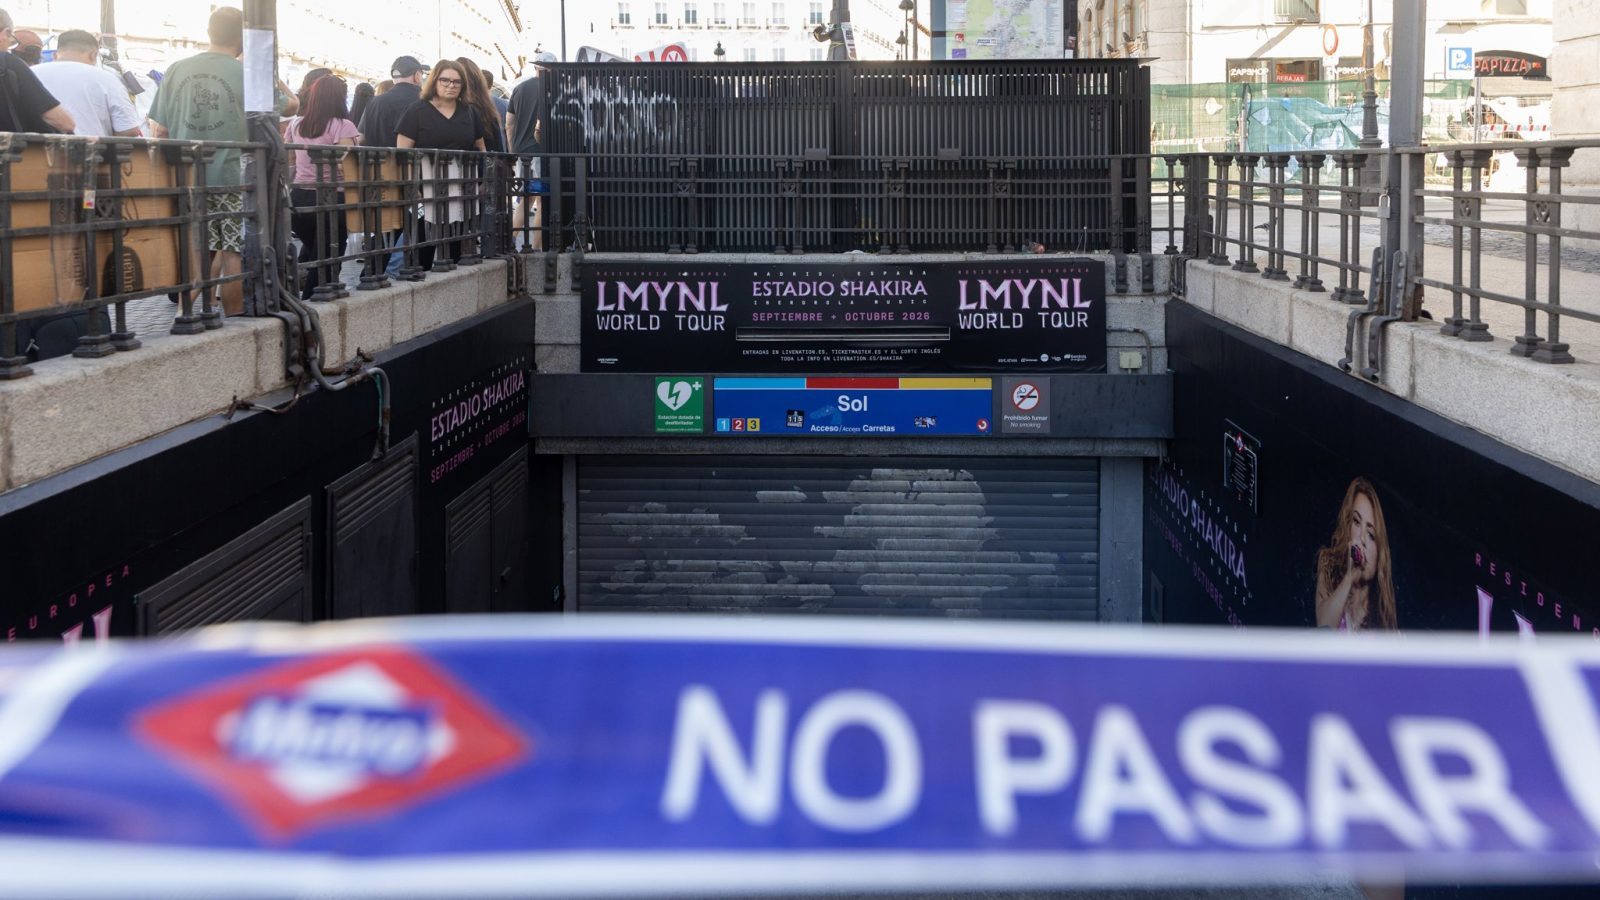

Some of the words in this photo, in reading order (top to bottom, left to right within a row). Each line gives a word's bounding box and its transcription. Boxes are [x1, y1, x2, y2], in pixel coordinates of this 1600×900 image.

[1230, 67, 1269, 76] ZAPSHOP
[596, 281, 729, 311] LMYNL
[752, 281, 835, 297] ESTADIO
[839, 280, 928, 297] SHAKIRA
[958, 278, 1093, 310] LMYNL
[596, 314, 660, 331] WORLD
[674, 314, 725, 331] TOUR
[752, 312, 823, 321] SEPTIEMBRE
[845, 312, 894, 321] OCTUBRE
[902, 311, 930, 321] 2026
[958, 312, 1024, 330] WORLD
[1037, 311, 1088, 329] TOUR
[431, 394, 481, 442] ESTADIO
[482, 369, 525, 412] SHAKIRA
[838, 395, 868, 412] Sol
[735, 420, 742, 429] 2
[750, 420, 757, 429] 3
[862, 424, 896, 432] Carretas
[431, 444, 475, 484] SEPTIEMBRE
[485, 420, 510, 446] OCTUBRE
[1191, 498, 1247, 588] SHAKIRA
[8, 565, 129, 642] EUROPEA
[238, 695, 432, 775] Metro
[660, 684, 921, 833] NO
[972, 699, 1551, 851] PASAR
